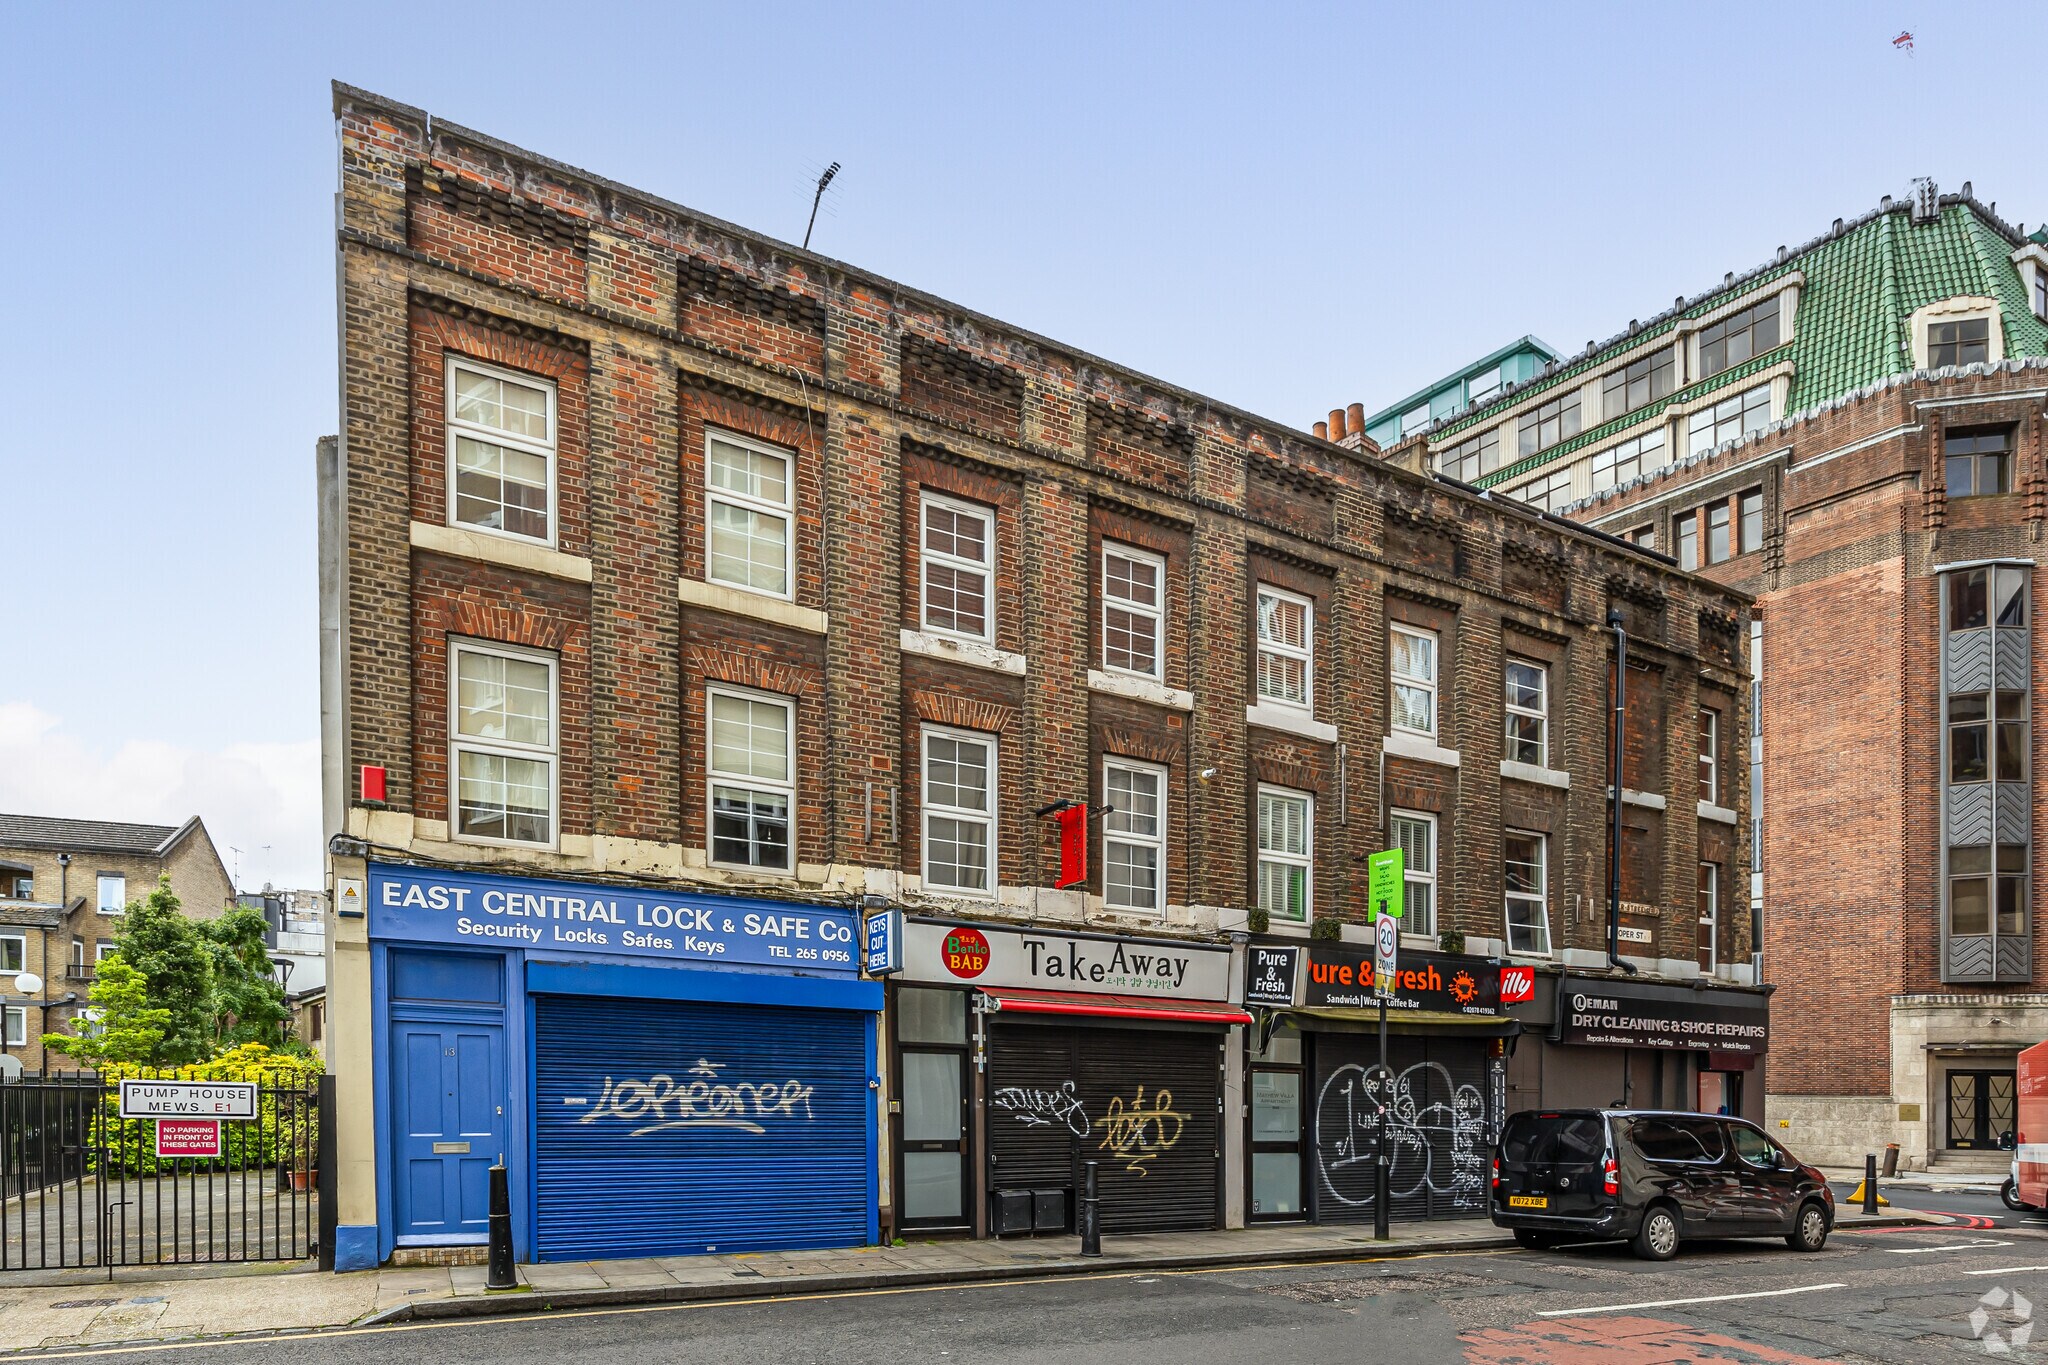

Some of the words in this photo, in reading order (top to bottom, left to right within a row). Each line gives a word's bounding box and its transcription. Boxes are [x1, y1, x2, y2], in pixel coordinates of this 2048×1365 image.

[382, 881, 471, 912] EAST
[482, 890, 626, 924] CENTRAL
[637, 903, 714, 932] LOCK
[722, 918, 735, 933] &
[743, 913, 810, 939] SAFE
[870, 918, 886, 935] KEYS
[1618, 930, 1634, 938] OPER
[1636, 931, 1644, 939] ST
[457, 917, 543, 943] Security
[685, 935, 725, 956] Keys
[871, 935, 884, 950] CUT
[1381, 928, 1393, 946] 20
[768, 945, 792, 958] TEL
[796, 947, 818, 960] 265
[822, 949, 850, 962] 0956
[947, 936, 988, 955] Bento
[870, 952, 886, 967] HERE
[950, 954, 983, 970] BAB
[1258, 950, 1287, 966] Pure
[1378, 959, 1394, 972] ZONE
[1266, 966, 1276, 981] &
[1358, 960, 1374, 987] &
[1395, 964, 1442, 991] resh
[1255, 978, 1285, 992] Fresh
[1502, 971, 1531, 998] illy
[1326, 994, 1360, 1005] Sandwich
[1363, 996, 1381, 1007] Wrap
[1408, 999, 1420, 1008] Bar
[1574, 994, 1618, 1011] LEMAN
[1572, 1013, 1601, 1028] DRY
[1601, 1015, 1670, 1032] CLEANING
[1670, 1020, 1680, 1032] &
[1680, 1021, 1715, 1035] SHOE
[1716, 1023, 1765, 1038] REPAIRS
[444, 1047, 456, 1057] 13
[1648, 1038, 1657, 1046] Key
[1722, 1041, 1735, 1050] Watch
[132, 1087, 179, 1098] PUMP
[189, 1089, 247, 1099] HOUSE
[214, 1103, 231, 1112] E1
